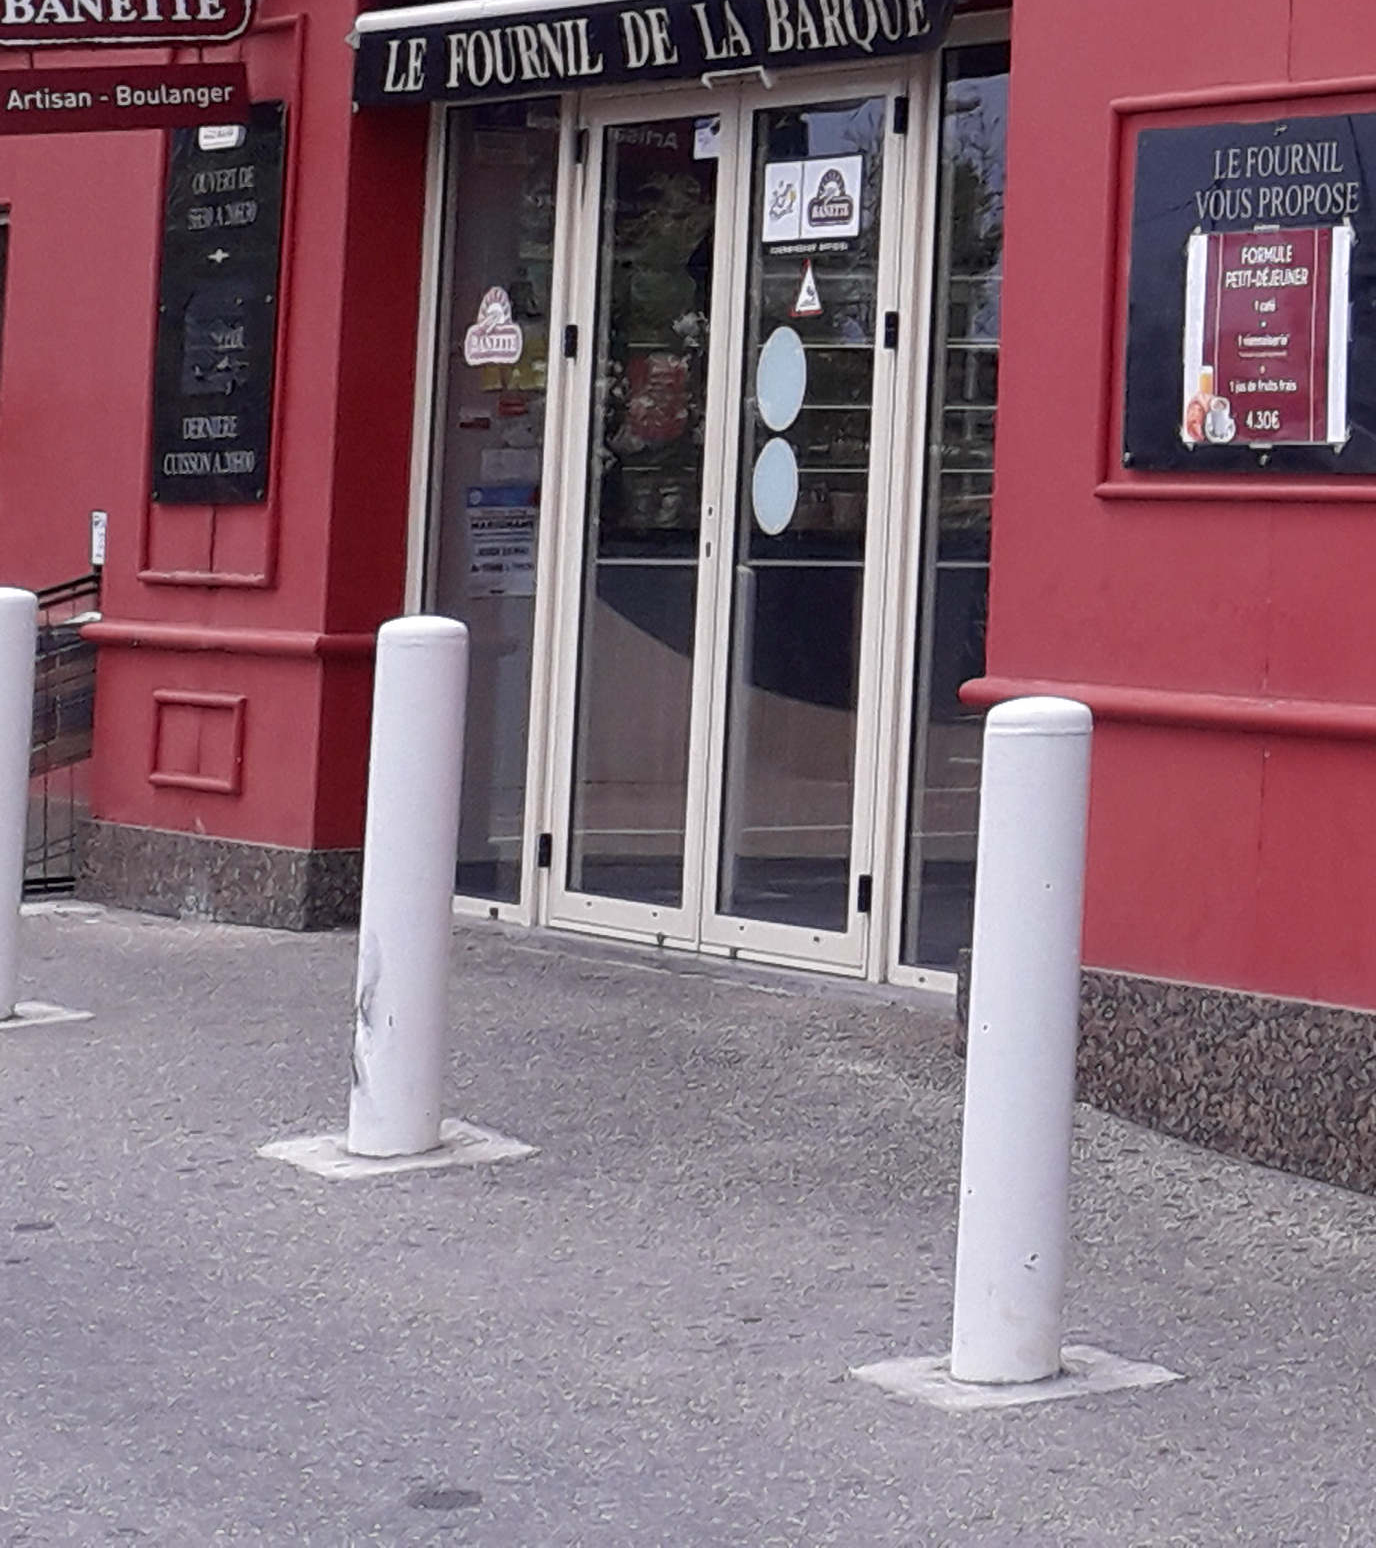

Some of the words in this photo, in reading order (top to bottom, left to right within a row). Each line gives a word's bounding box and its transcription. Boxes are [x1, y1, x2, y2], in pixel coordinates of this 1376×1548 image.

[384, 37, 426, 92] LE
[446, 18, 604, 89] FOURNIL
[619, 8, 679, 69] DE
[693, 1, 752, 60] LA
[7, 88, 92, 111] Artisan
[115, 84, 234, 109] Boulanger
[1213, 148, 1241, 181] LE
[1246, 141, 1344, 177] FOURNIL
[1195, 187, 1252, 221] VOUS
[1257, 181, 1361, 217] PROPOSE
[1240, 244, 1293, 265] FORMULE
